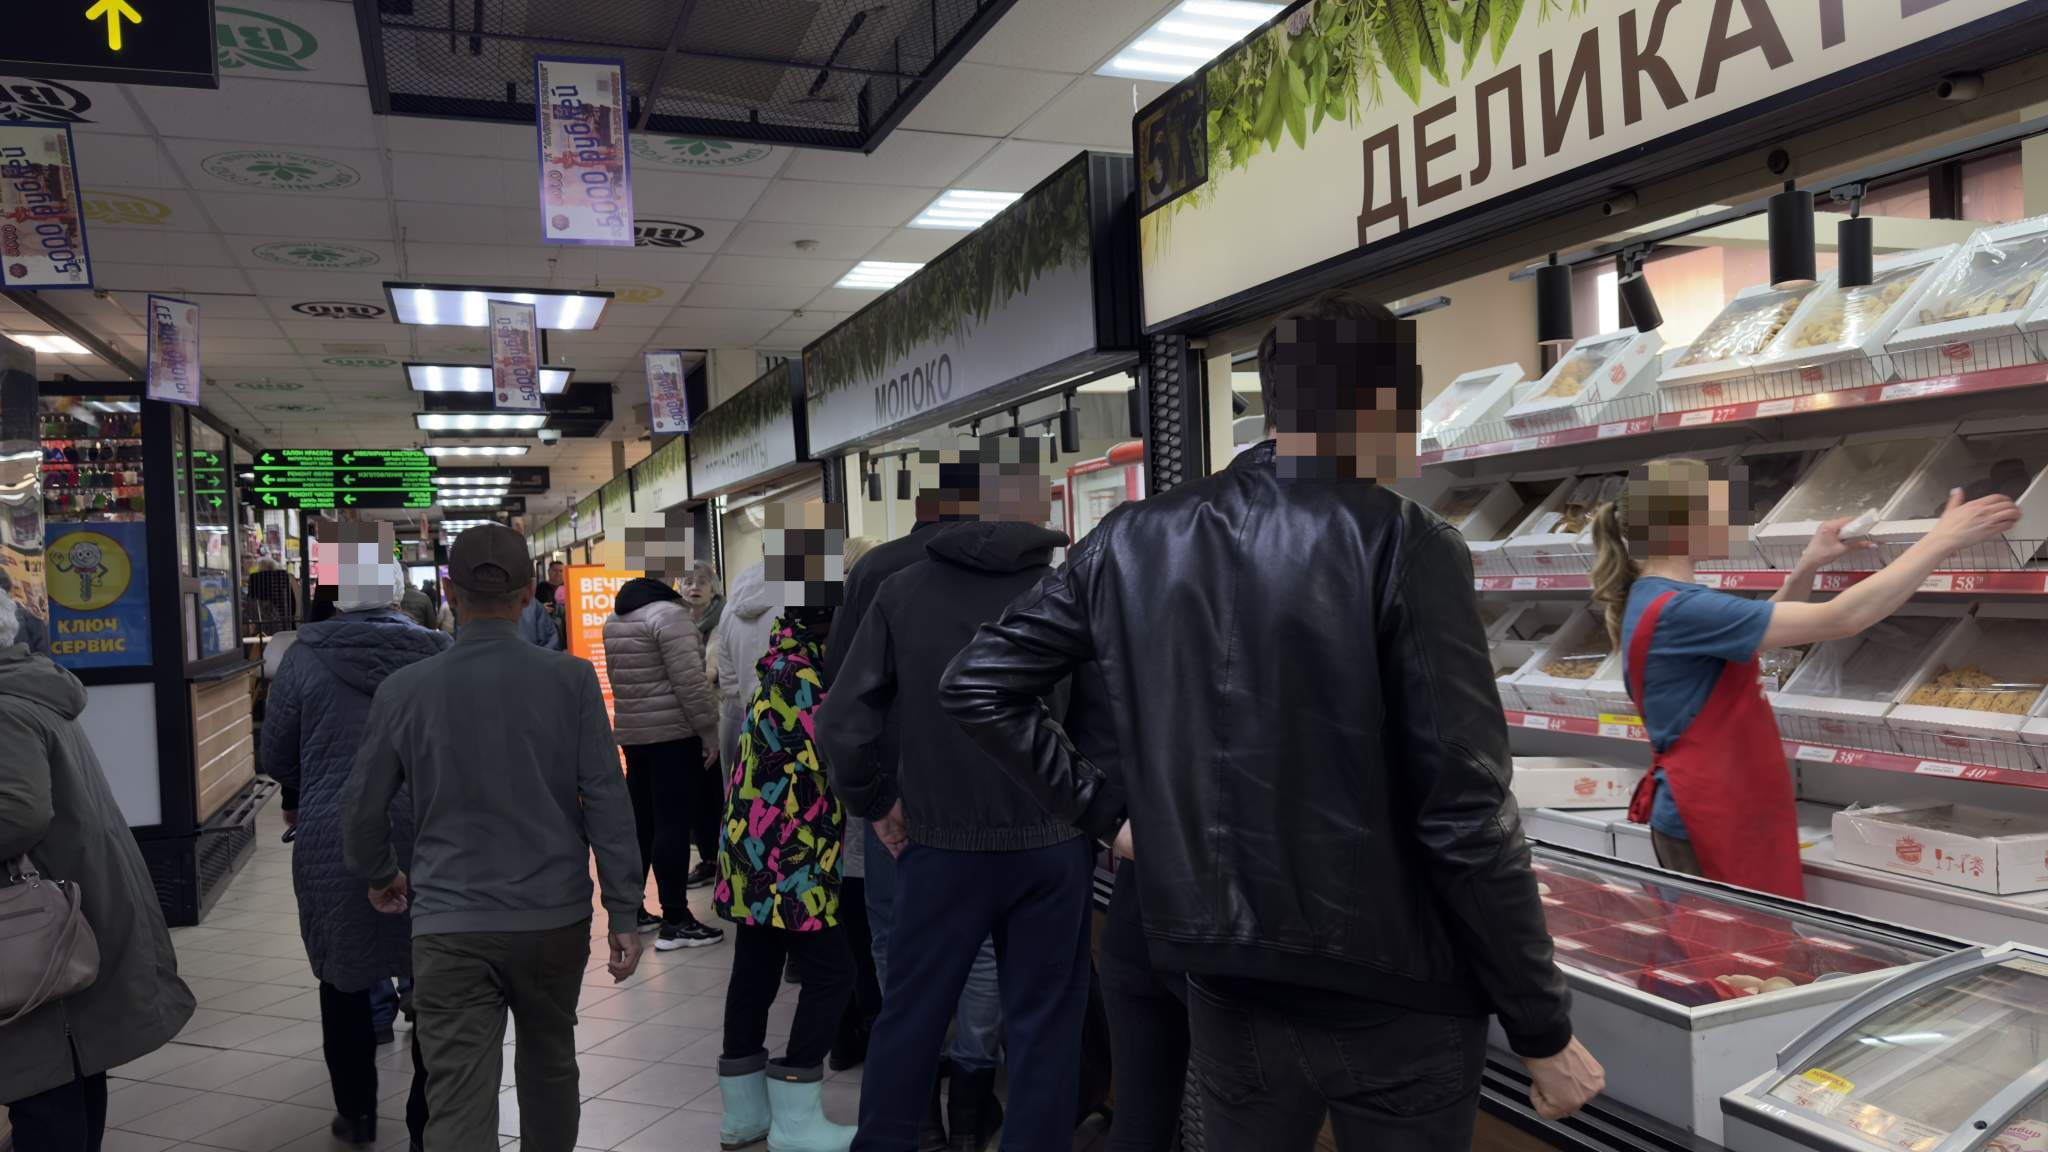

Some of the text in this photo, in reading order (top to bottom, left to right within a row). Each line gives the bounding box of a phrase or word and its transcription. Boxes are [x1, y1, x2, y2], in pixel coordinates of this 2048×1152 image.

[1356, 0, 1950, 244] ДЕЛИКА
[552, 85, 624, 228] 5000 рублей
[35, 224, 82, 274] 5000
[875, 352, 953, 425] МОЛОКО
[50, 637, 126, 655] СЕРВИС
[57, 617, 118, 634] КЛЮЧ
